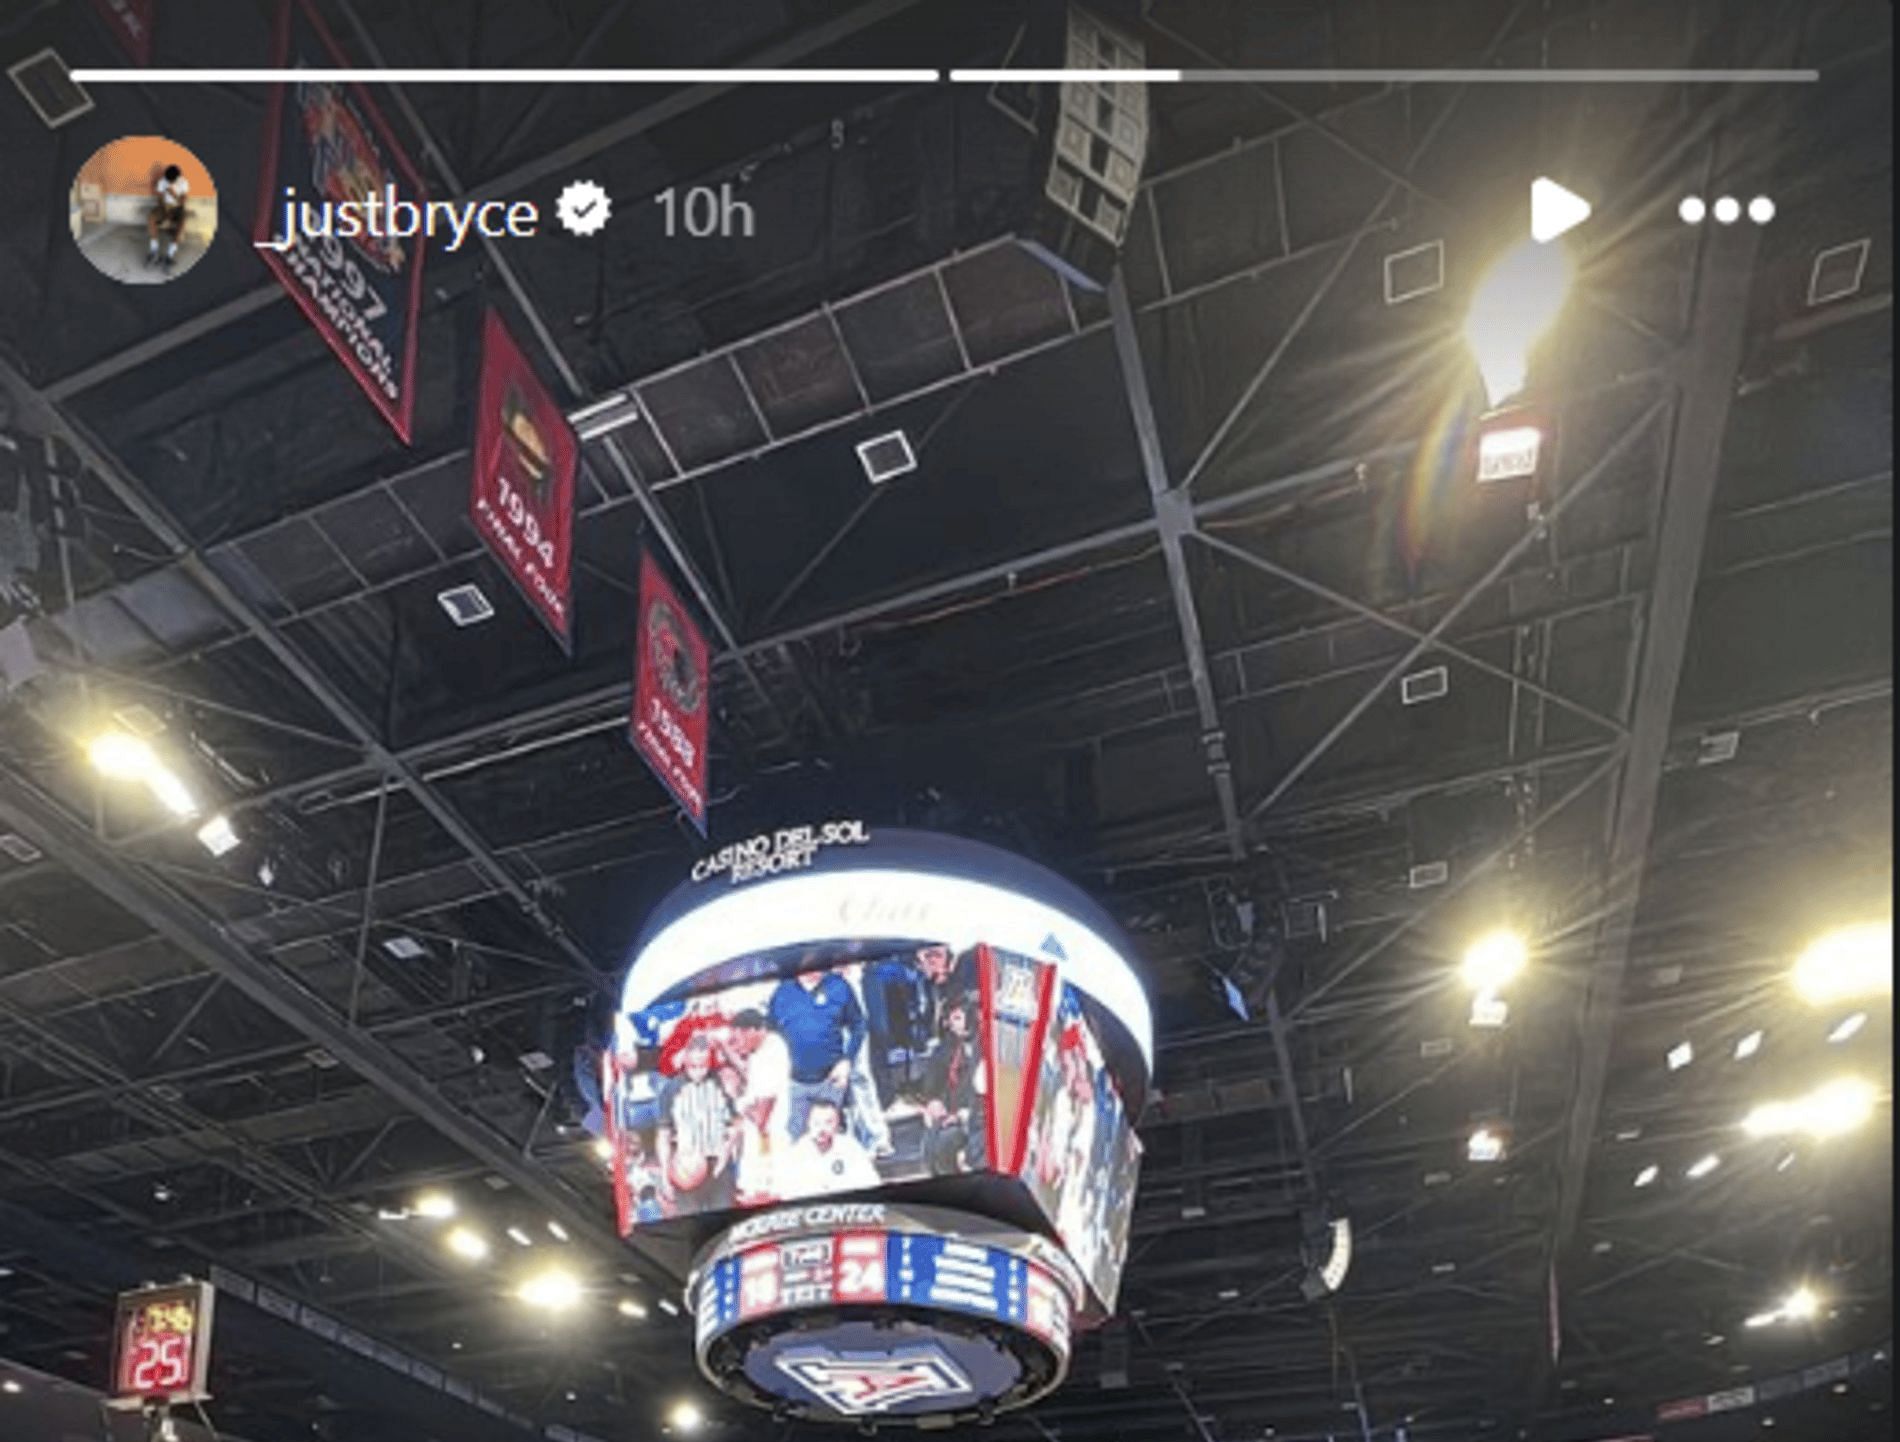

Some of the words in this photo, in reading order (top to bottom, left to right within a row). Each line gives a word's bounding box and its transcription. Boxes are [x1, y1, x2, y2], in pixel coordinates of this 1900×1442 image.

[499, 476, 555, 569] 1994
[691, 834, 771, 882] CASINO
[774, 826, 819, 853] DEL
[821, 820, 871, 846] SOL
[805, 1203, 888, 1226] CENTER
[838, 1258, 887, 1294] 24
[134, 1339, 182, 1390] 25
